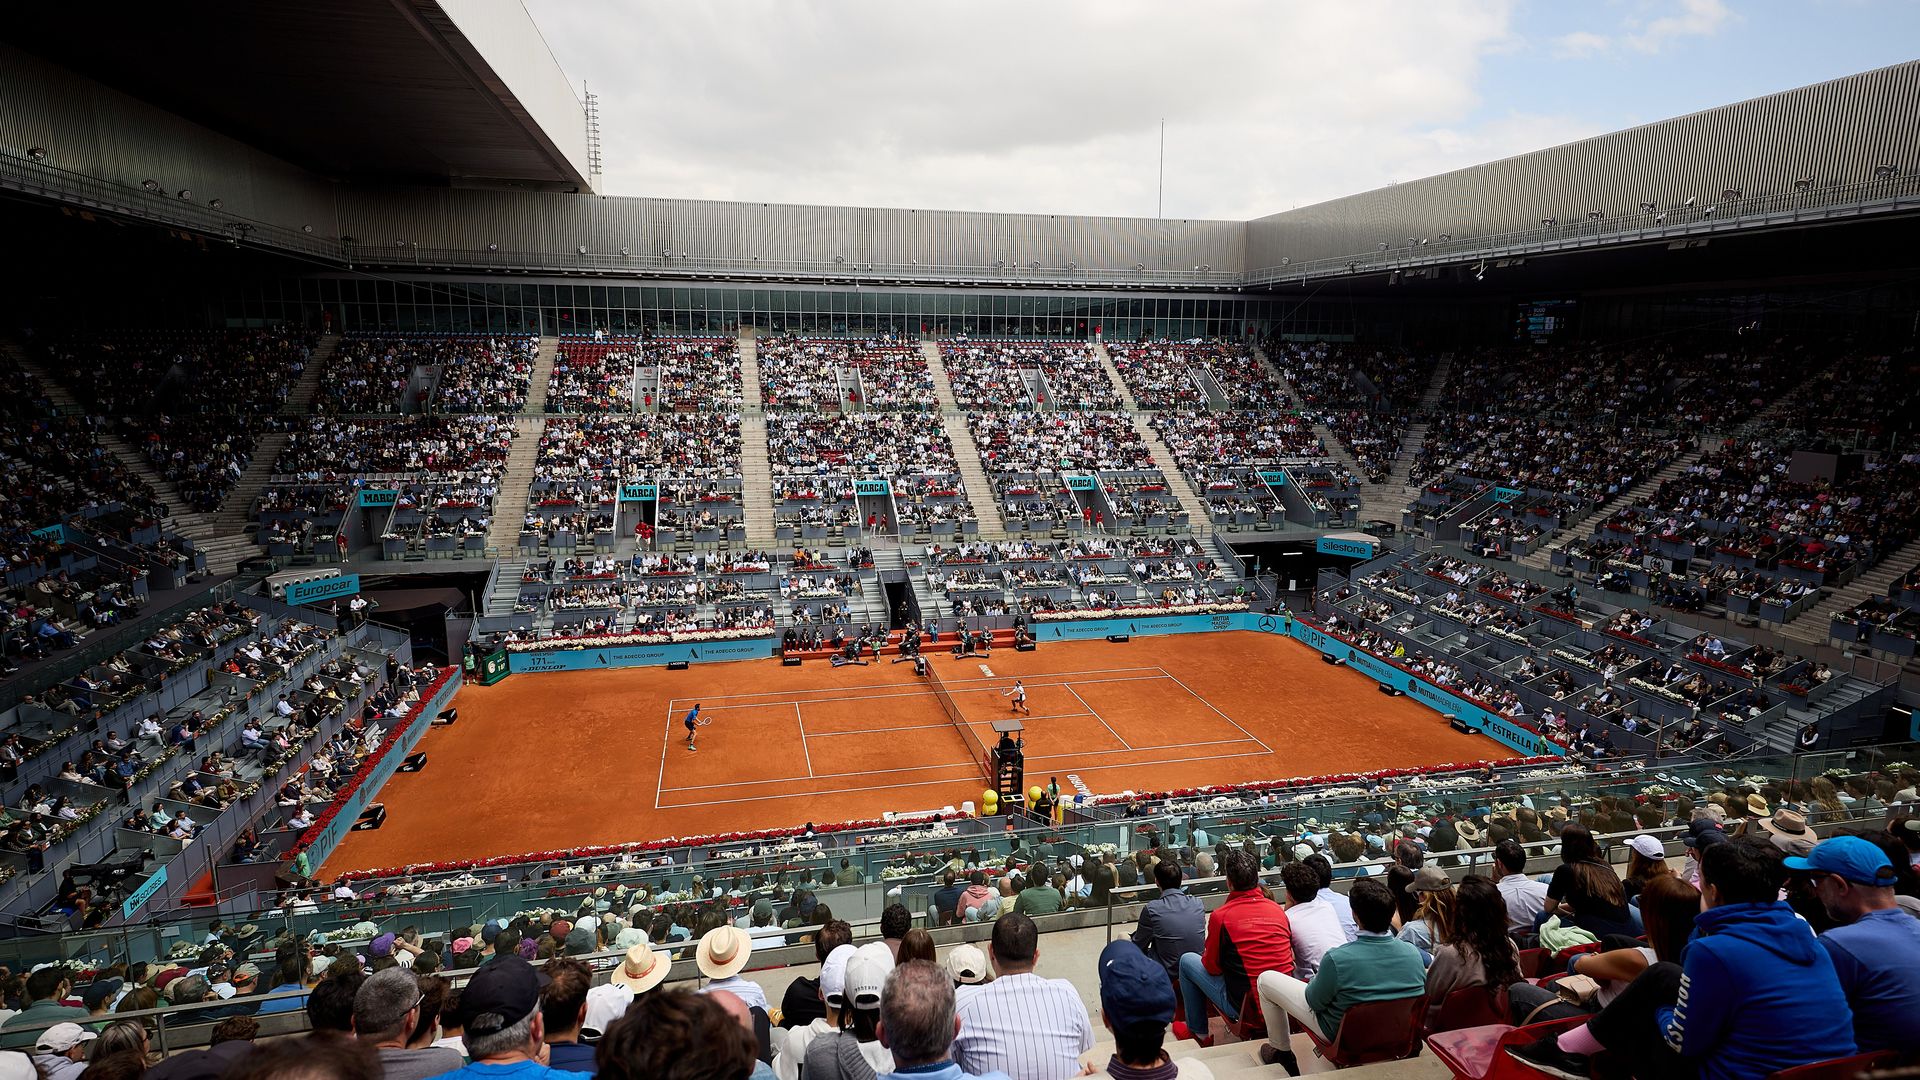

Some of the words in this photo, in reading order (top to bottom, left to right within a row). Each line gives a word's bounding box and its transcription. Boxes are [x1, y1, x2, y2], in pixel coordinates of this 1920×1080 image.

[624, 489, 654, 497] MARCA
[857, 484, 884, 492] MARCA
[1323, 542, 1366, 554] silestone
[295, 580, 352, 598] Europcar
[1311, 632, 1327, 648] PIF
[532, 657, 547, 665] 171
[527, 664, 567, 672] DUNLOP
[1492, 724, 1531, 750] ESTRELLA
[320, 821, 337, 858] PIF
